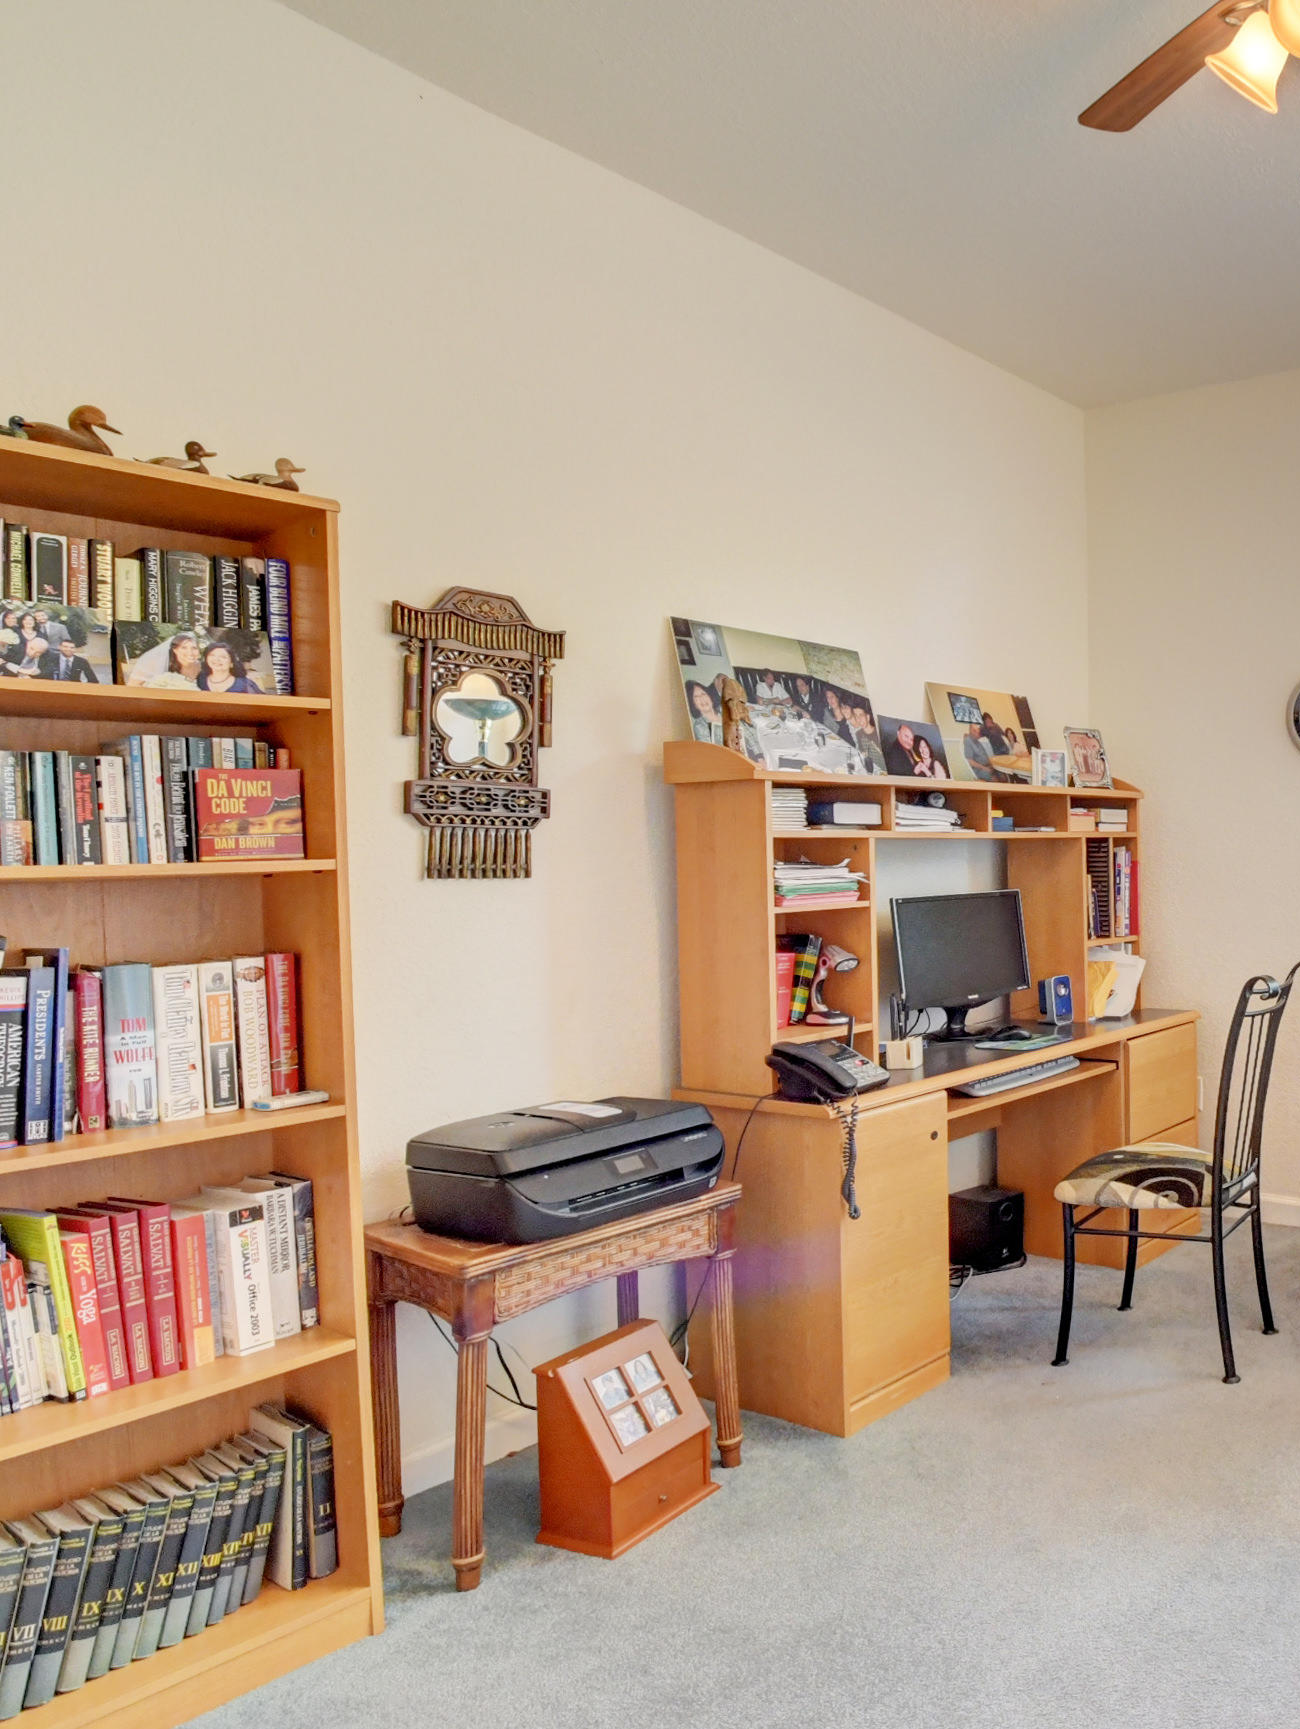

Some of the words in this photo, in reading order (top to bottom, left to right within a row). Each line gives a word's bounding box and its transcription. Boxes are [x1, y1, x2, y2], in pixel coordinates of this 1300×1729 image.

[10, 531, 22, 561] MICHAEL
[96, 544, 112, 583] STUART
[148, 552, 157, 575] MARY
[221, 560, 238, 586] JACK
[269, 562, 287, 587] FOUR
[11, 563, 22, 598] CONNELLY
[149, 578, 158, 613] HIGGINS
[247, 585, 261, 617] JAMES
[270, 588, 287, 614] BLIND
[4, 766, 15, 783] KEN
[207, 778, 228, 797] DA
[231, 778, 272, 797] VINCI
[4, 786, 15, 819] FOLLETT
[212, 798, 247, 814] CODE
[215, 838, 235, 849] DAN
[239, 837, 275, 848] BROWN
[81, 1005, 97, 1022] THE
[256, 990, 265, 1018] PLAN
[34, 989, 50, 1061] PRESIDENTS
[82, 1025, 98, 1045] KITE
[120, 1017, 147, 1033] TOM
[7, 1023, 22, 1087] AMERICAN
[83, 1048, 99, 1083] RUNNER
[113, 1046, 155, 1064] WOLFE
[243, 1017, 259, 1090] WOODWARD
[259, 1043, 271, 1087] ATTACK
[266, 1194, 275, 1227] BARBARA
[278, 1201, 287, 1235] DISTANT
[91, 1236, 107, 1282] SALVAT
[119, 1230, 136, 1275] SALVAT
[149, 1224, 163, 1269] SALVAT
[268, 1238, 278, 1274] TUCHMAN
[279, 1236, 290, 1273] MIRROR
[77, 1289, 97, 1325] Yoga
[247, 1284, 257, 1312] Office
[251, 1314, 260, 1336] 2003
[255, 1522, 274, 1537] XIV
[176, 1561, 199, 1576] XII
[202, 1552, 223, 1567] XIII
[132, 1581, 147, 1596] X
[156, 1572, 175, 1587] XI
[82, 1600, 102, 1616] IX
[106, 1587, 126, 1603] IX
[14, 1624, 37, 1639] VII
[43, 1616, 69, 1632] VIII
